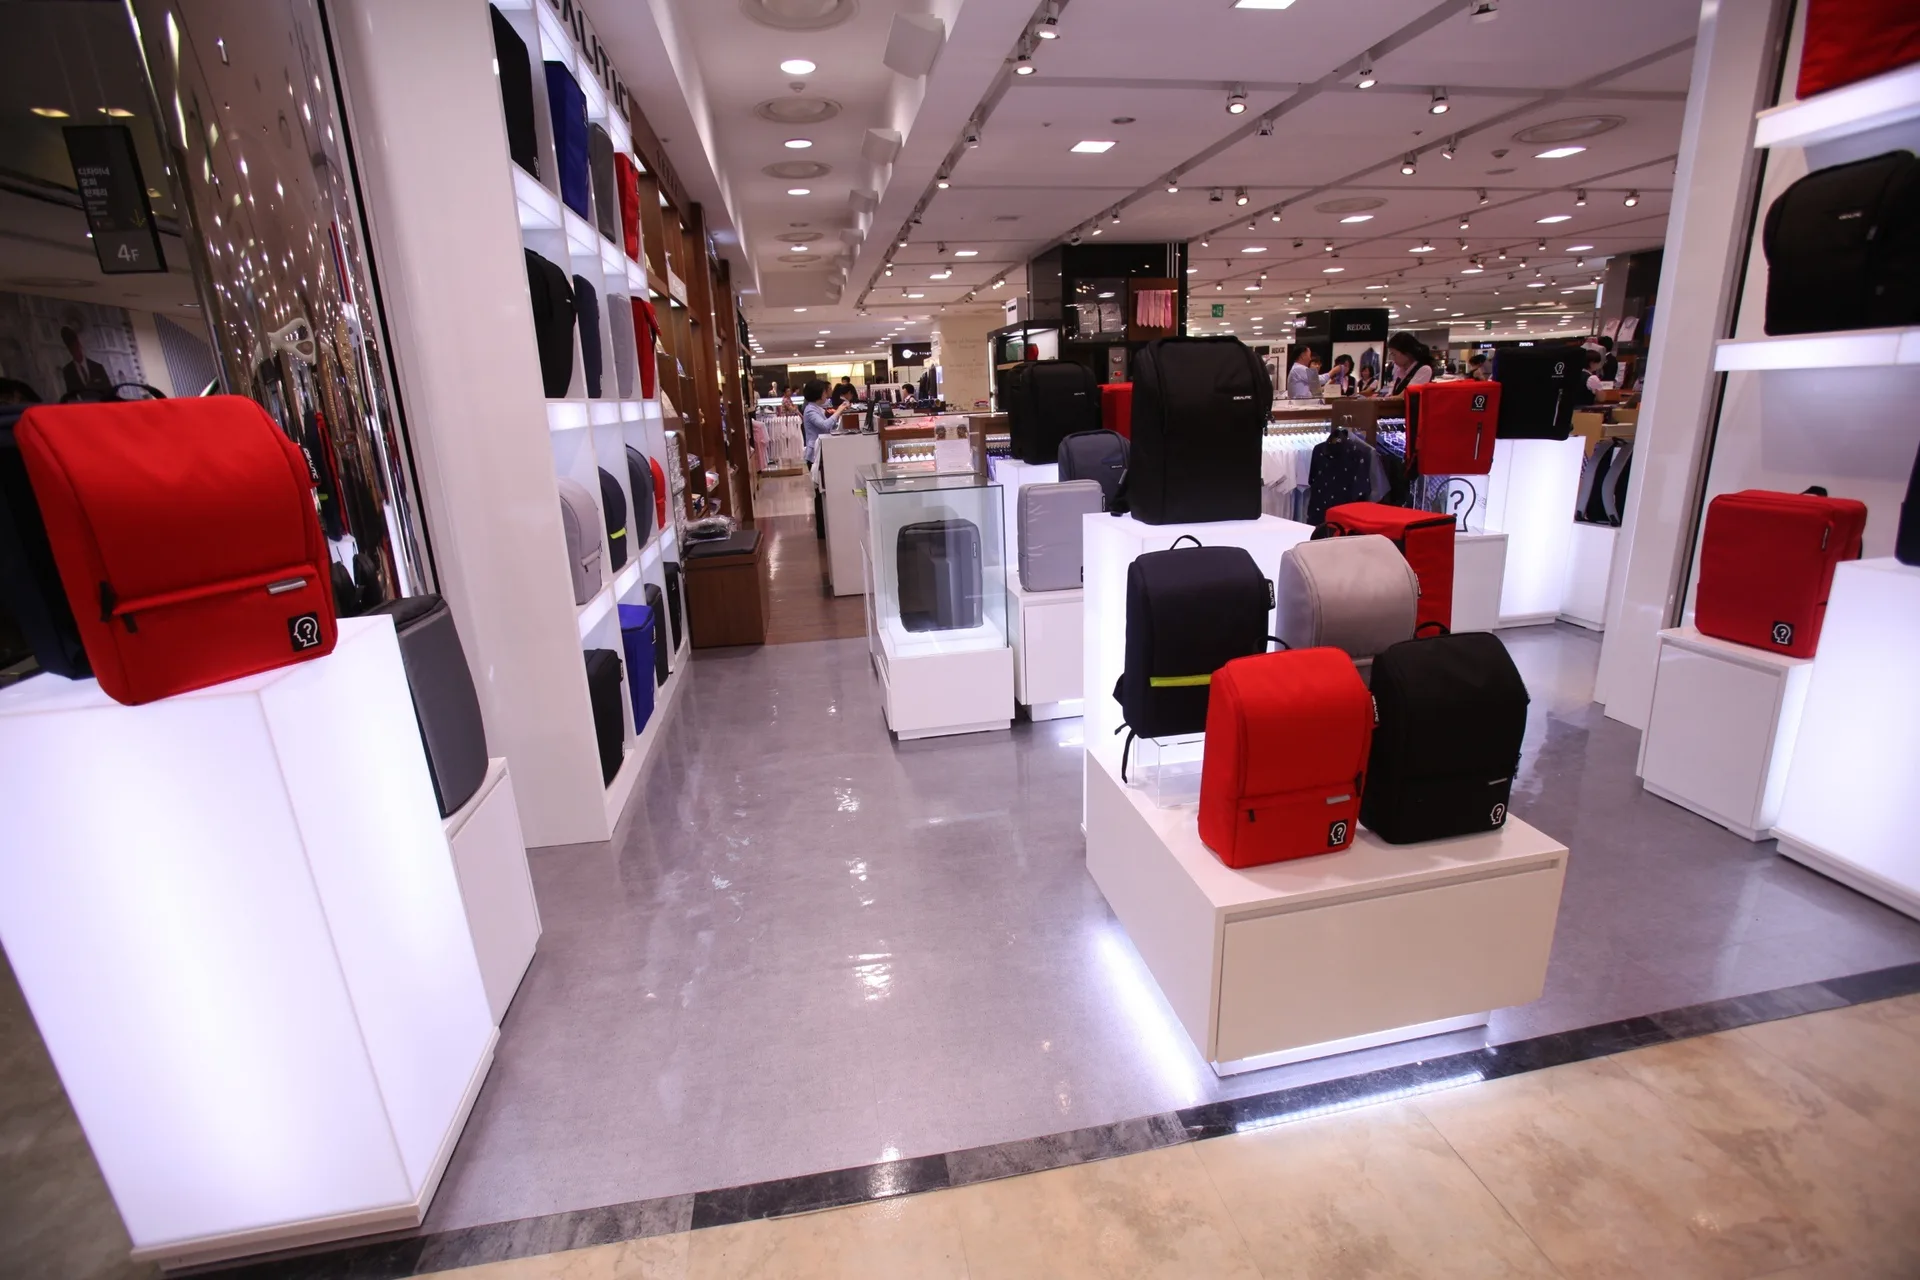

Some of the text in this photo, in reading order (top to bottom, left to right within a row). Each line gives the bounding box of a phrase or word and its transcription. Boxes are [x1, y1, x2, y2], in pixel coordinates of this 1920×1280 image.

[551, 0, 630, 122] ALITIC
[117, 243, 140, 261] 4F
[1346, 323, 1371, 331] REDOX
